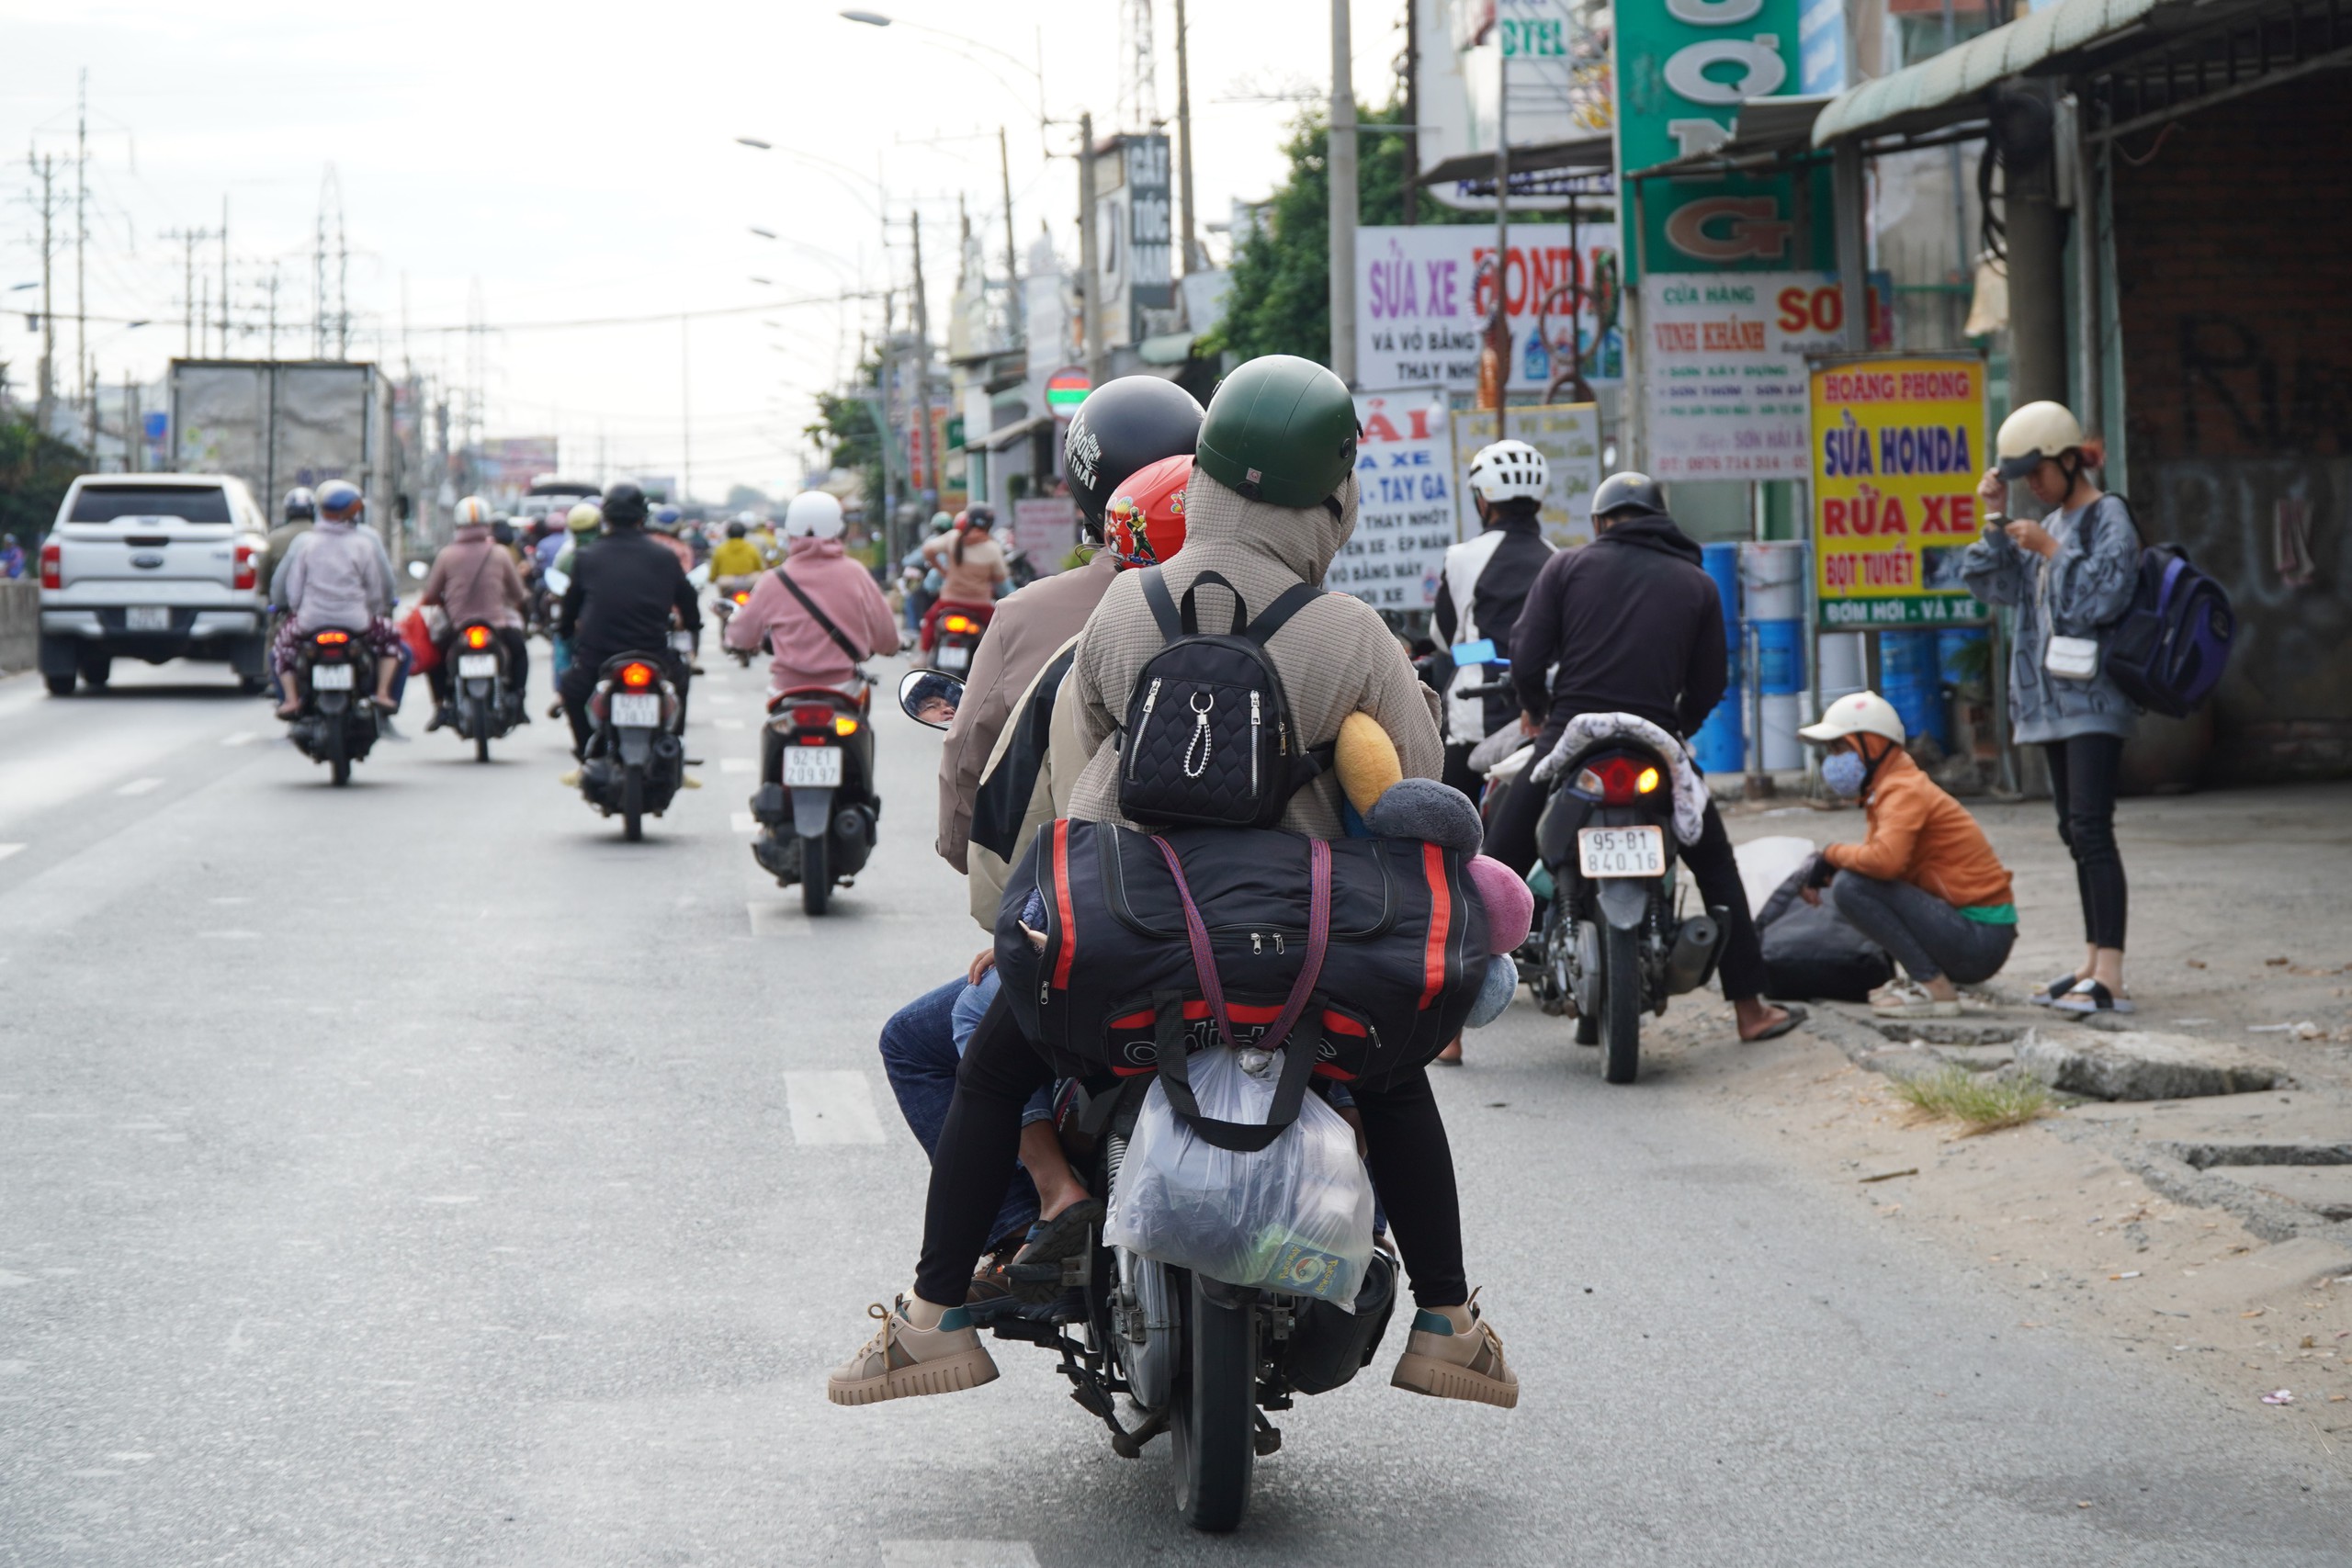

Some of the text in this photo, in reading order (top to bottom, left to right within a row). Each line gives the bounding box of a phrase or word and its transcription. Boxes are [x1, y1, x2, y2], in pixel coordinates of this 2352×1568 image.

[1501, 17, 1566, 57] OTEL
[1369, 237, 1419, 319] SỬA
[1426, 259, 1459, 317] XE
[1396, 362, 1441, 381] THAY
[1824, 367, 1971, 402] HOÀNG PHONG
[1357, 398, 1431, 445] ẢI
[1390, 450, 1431, 468] XE
[1824, 408, 1973, 478] SỬA HONDA
[1379, 472, 1448, 503] TAY GA
[1365, 513, 1403, 530] THAY
[1822, 482, 1977, 537] RỬA XE
[1825, 539, 1916, 595] BỌT TUYẾT
[1951, 598, 1977, 619] XE
[1593, 830, 1647, 852] 95-B1
[1588, 852, 1658, 872] 840.16
